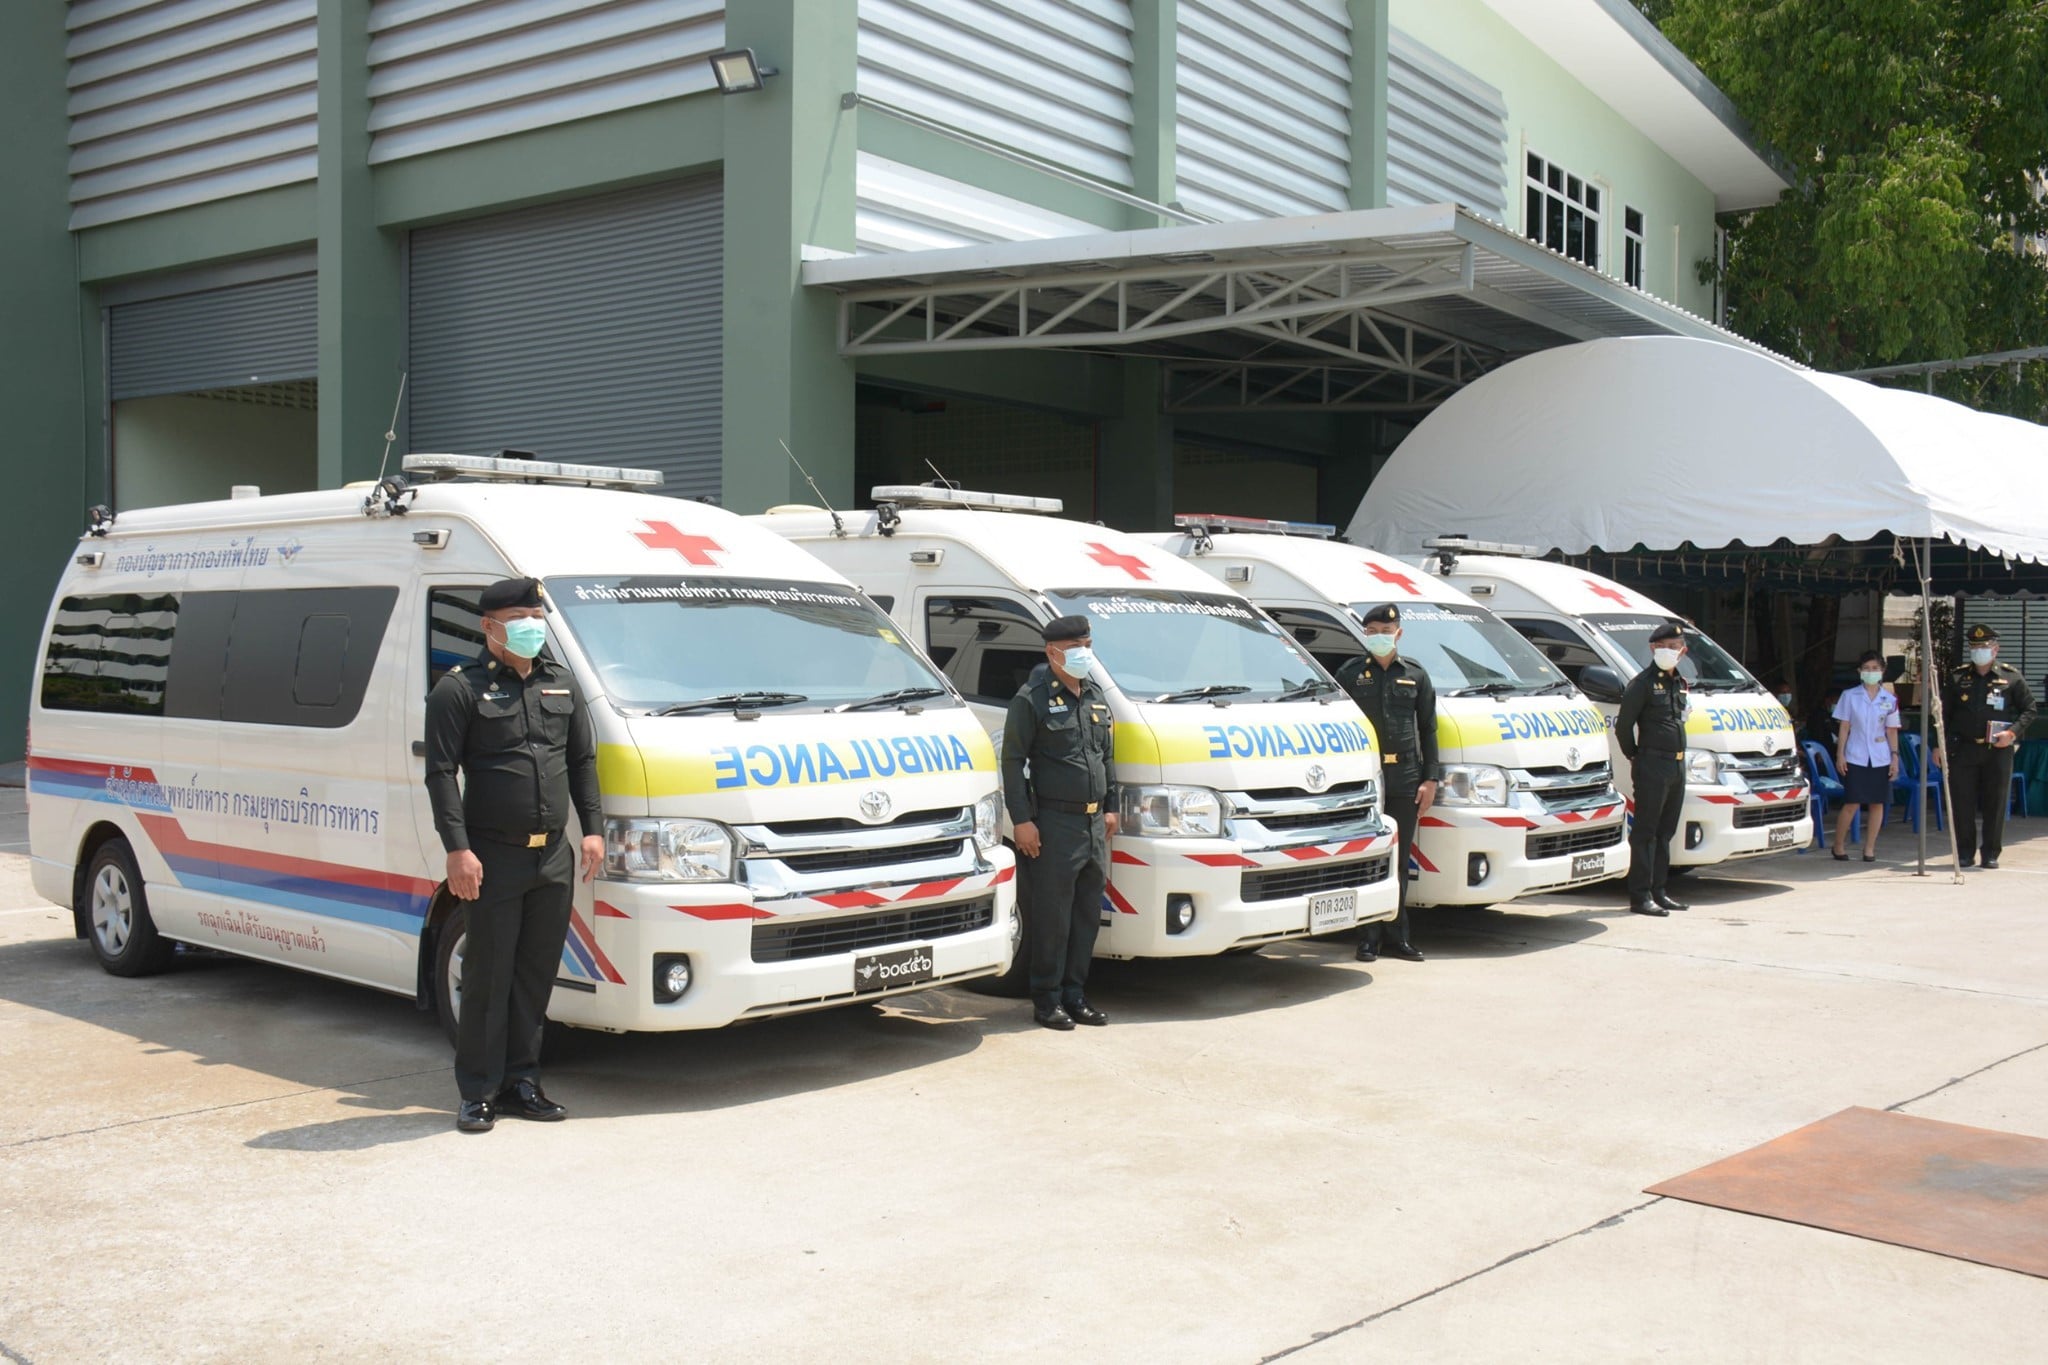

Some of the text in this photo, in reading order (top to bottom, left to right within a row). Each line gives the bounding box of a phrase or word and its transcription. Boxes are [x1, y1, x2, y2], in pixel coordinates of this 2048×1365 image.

[116, 536, 270, 578] กองบัญชาการกองทัพไทย
[575, 581, 731, 600] สำนักงานแพทย์ทหาร
[233, 786, 380, 835] กรมยุทธบริการทหาร
[1333, 896, 1354, 912] 3203
[198, 910, 326, 953] รถฉุกเฉินได้รับอนุญาตแล้ว
